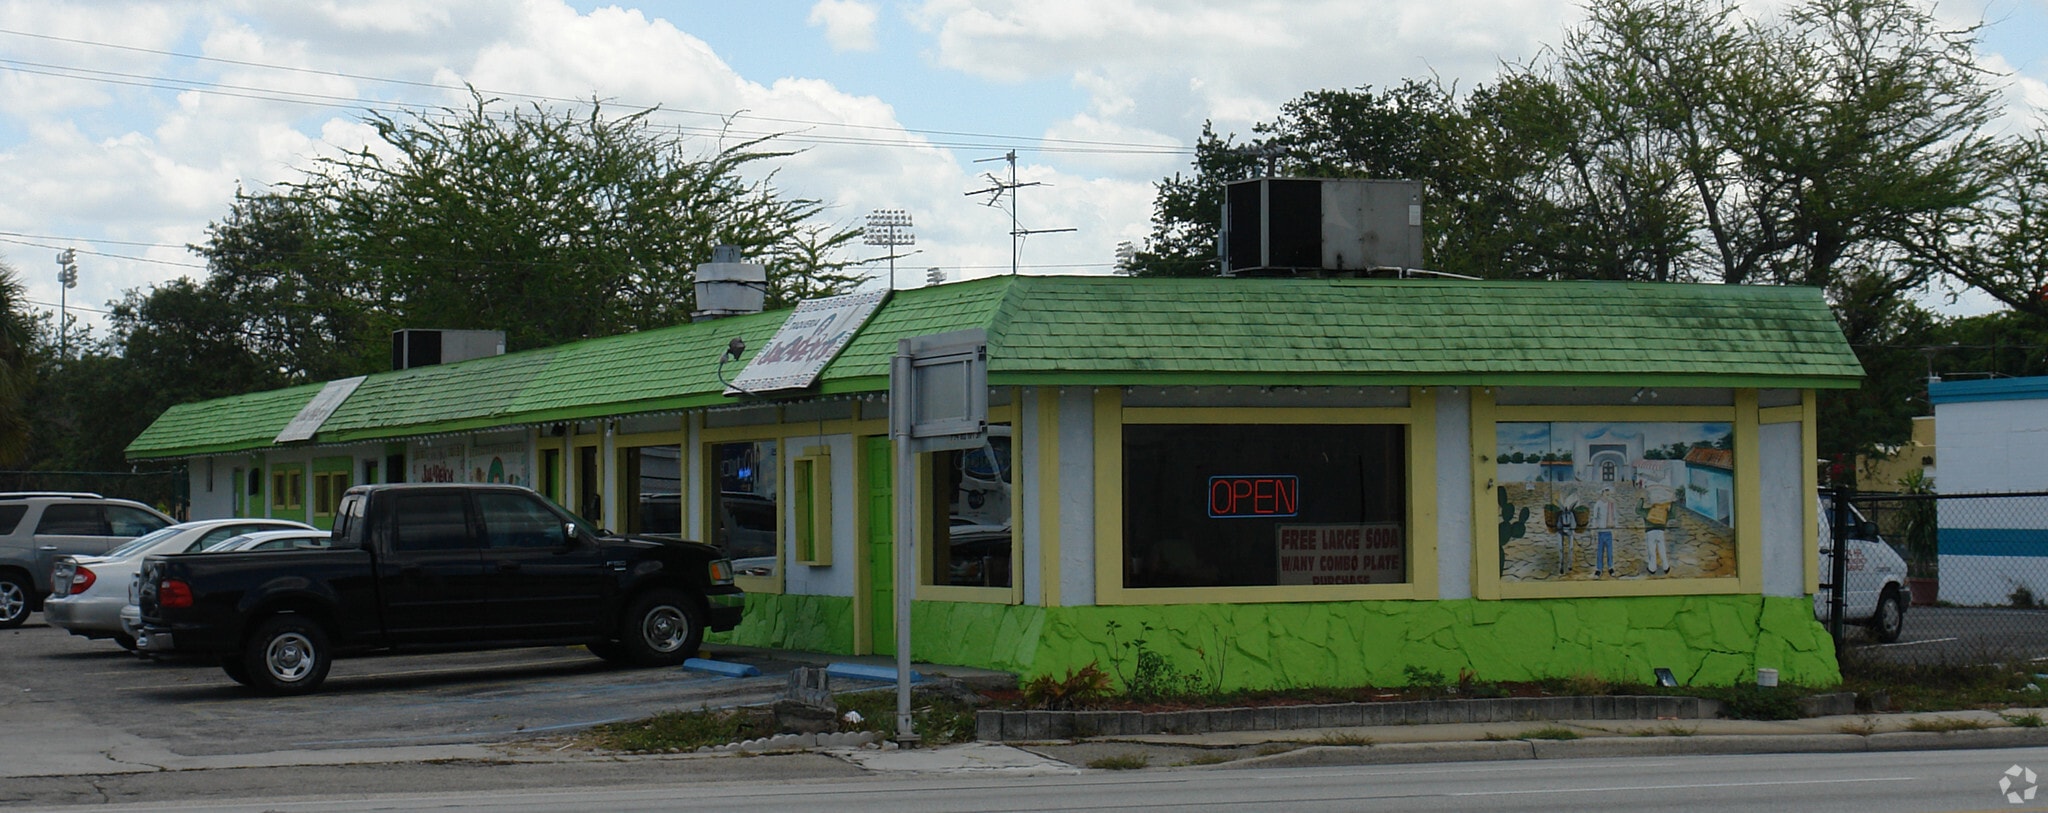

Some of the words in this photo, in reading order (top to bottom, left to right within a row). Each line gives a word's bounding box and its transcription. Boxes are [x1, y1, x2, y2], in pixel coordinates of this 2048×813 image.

[1211, 479, 1295, 514] OPEN
[1281, 529, 1316, 550] FREE
[1322, 528, 1360, 550] LARGE
[1365, 528, 1399, 549] SODA
[1319, 555, 1358, 571] COMBO
[1363, 555, 1399, 570] PLATE
